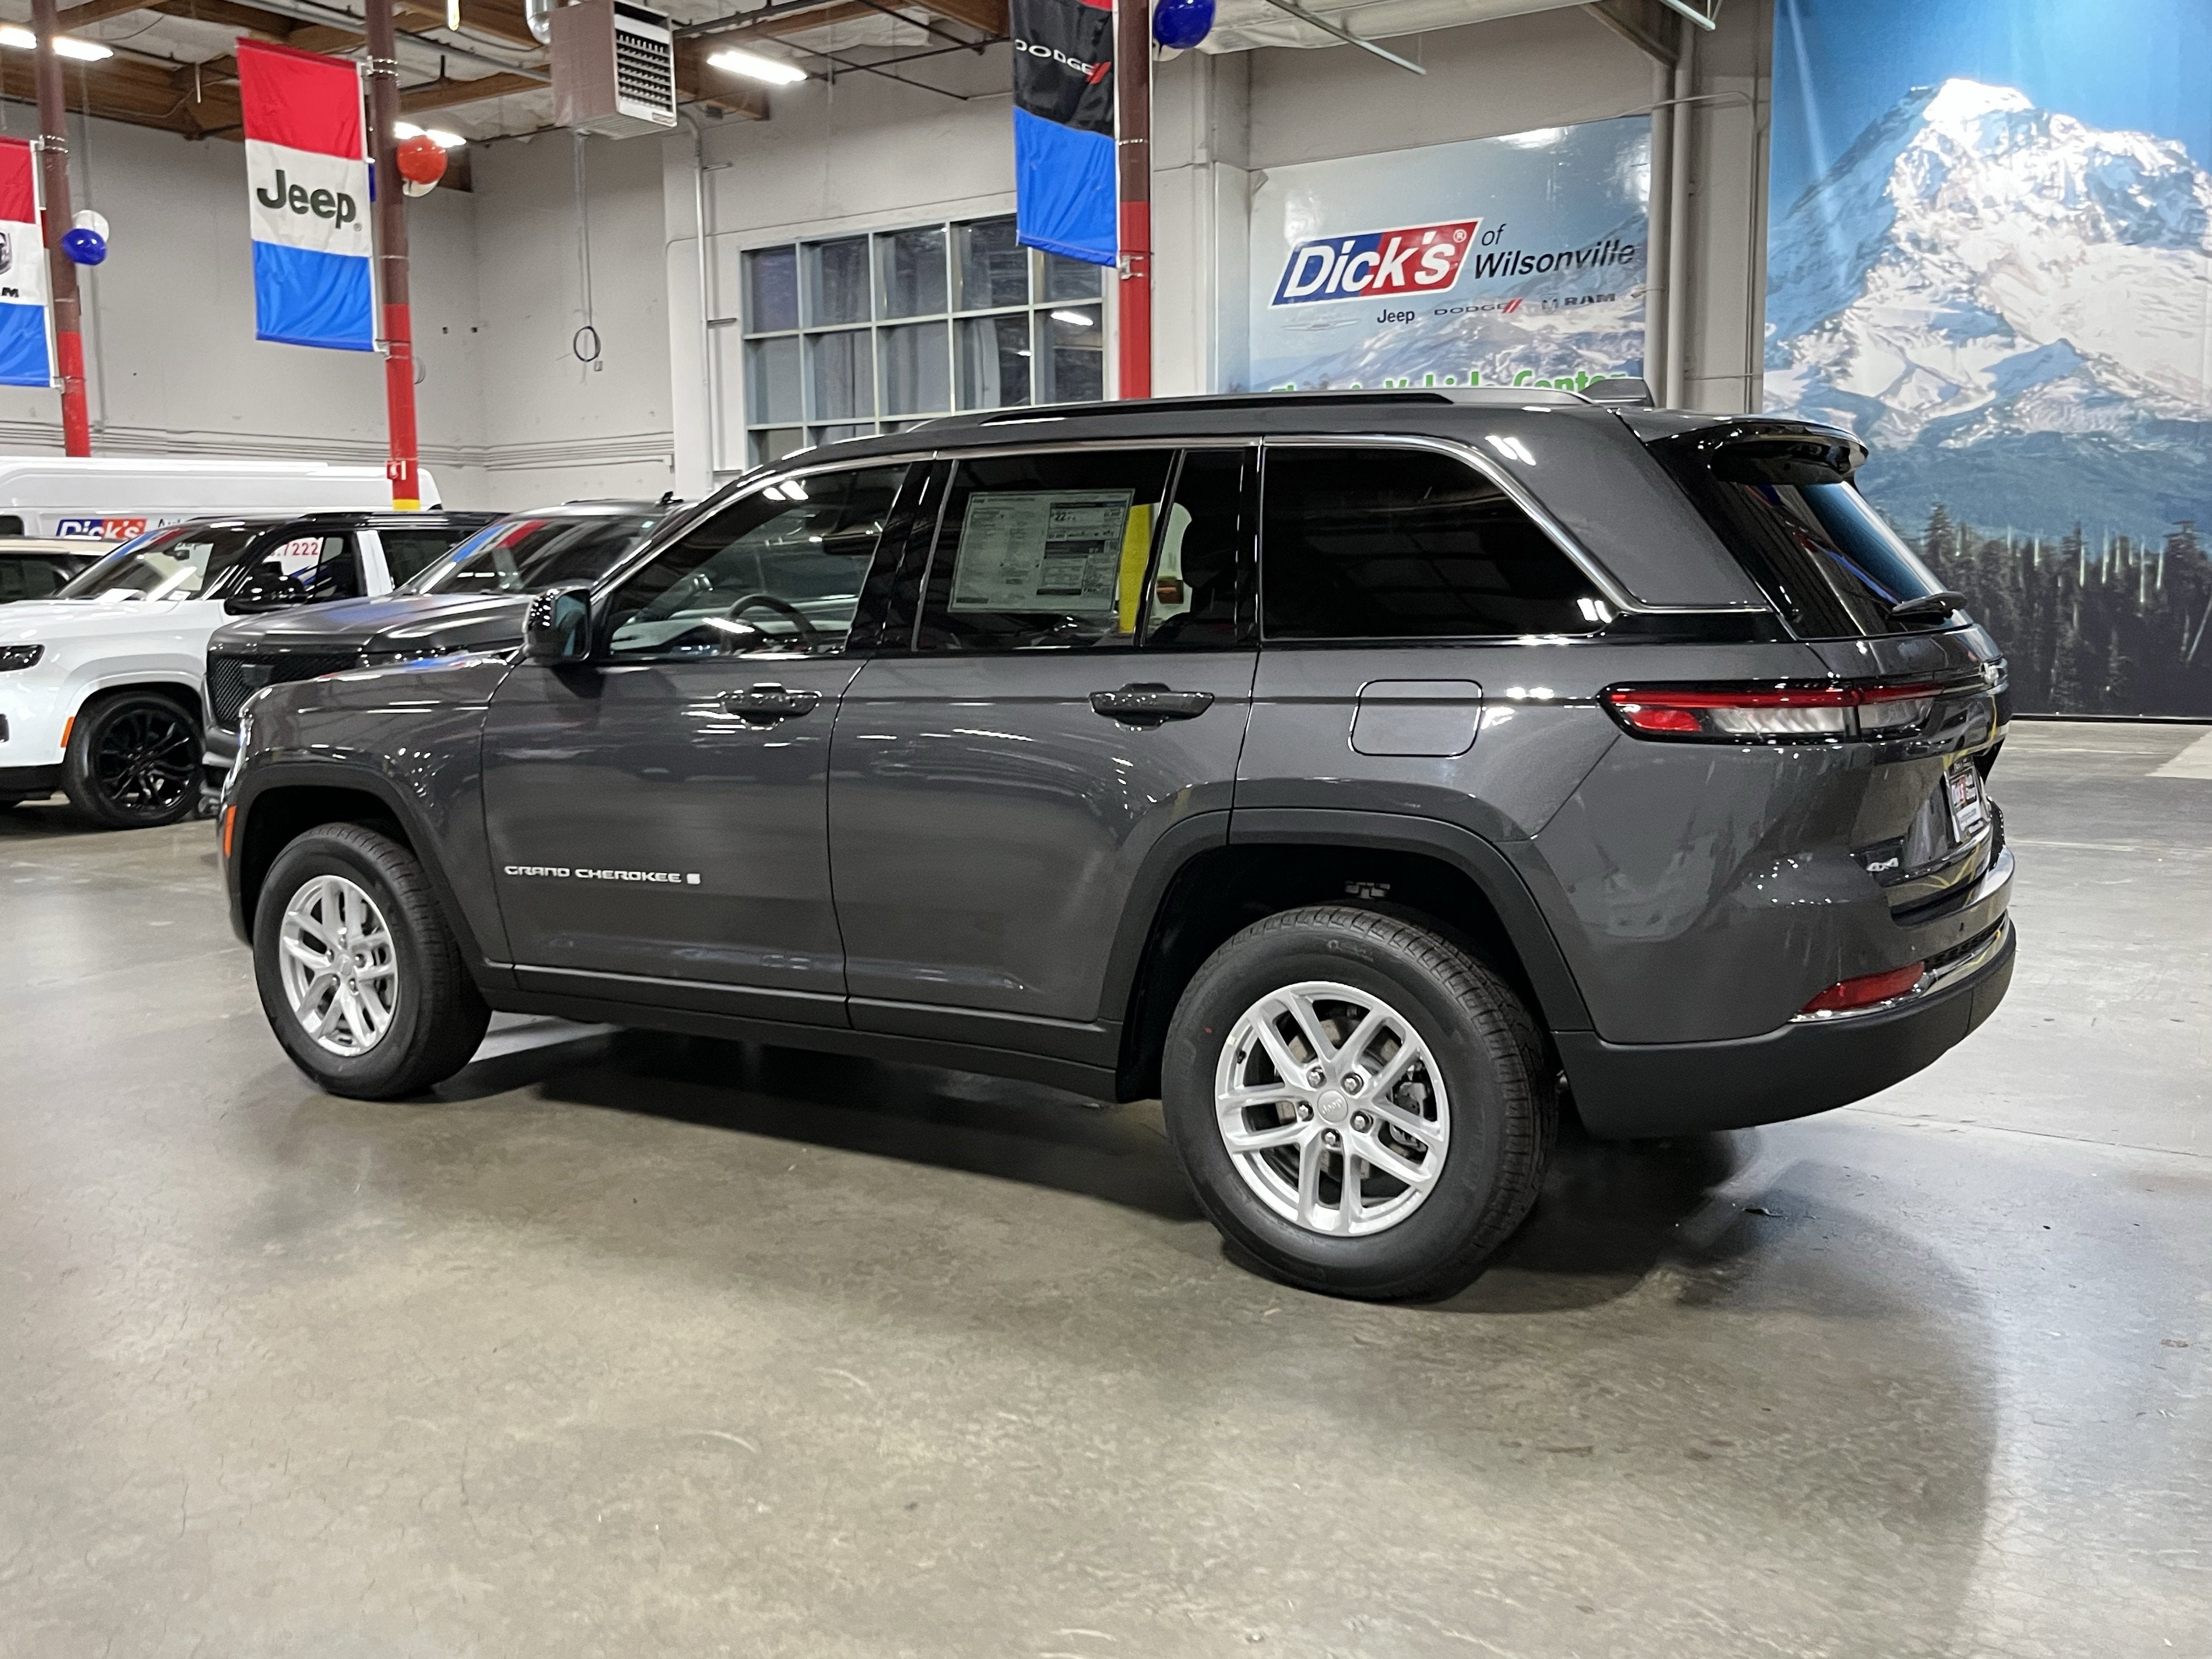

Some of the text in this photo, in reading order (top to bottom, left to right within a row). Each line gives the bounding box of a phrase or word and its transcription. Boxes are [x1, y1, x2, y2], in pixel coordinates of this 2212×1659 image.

[1015, 39, 1094, 76] DODGE
[257, 169, 356, 229] Jeep
[1481, 223, 1506, 246] of
[1283, 231, 1455, 298] Dick's
[1475, 239, 1635, 279] Wilsonville
[1377, 293, 1616, 324] Jeep DODGE RAM
[59, 520, 140, 540] Dick's
[504, 865, 682, 883] GRAND CHEROKEE
